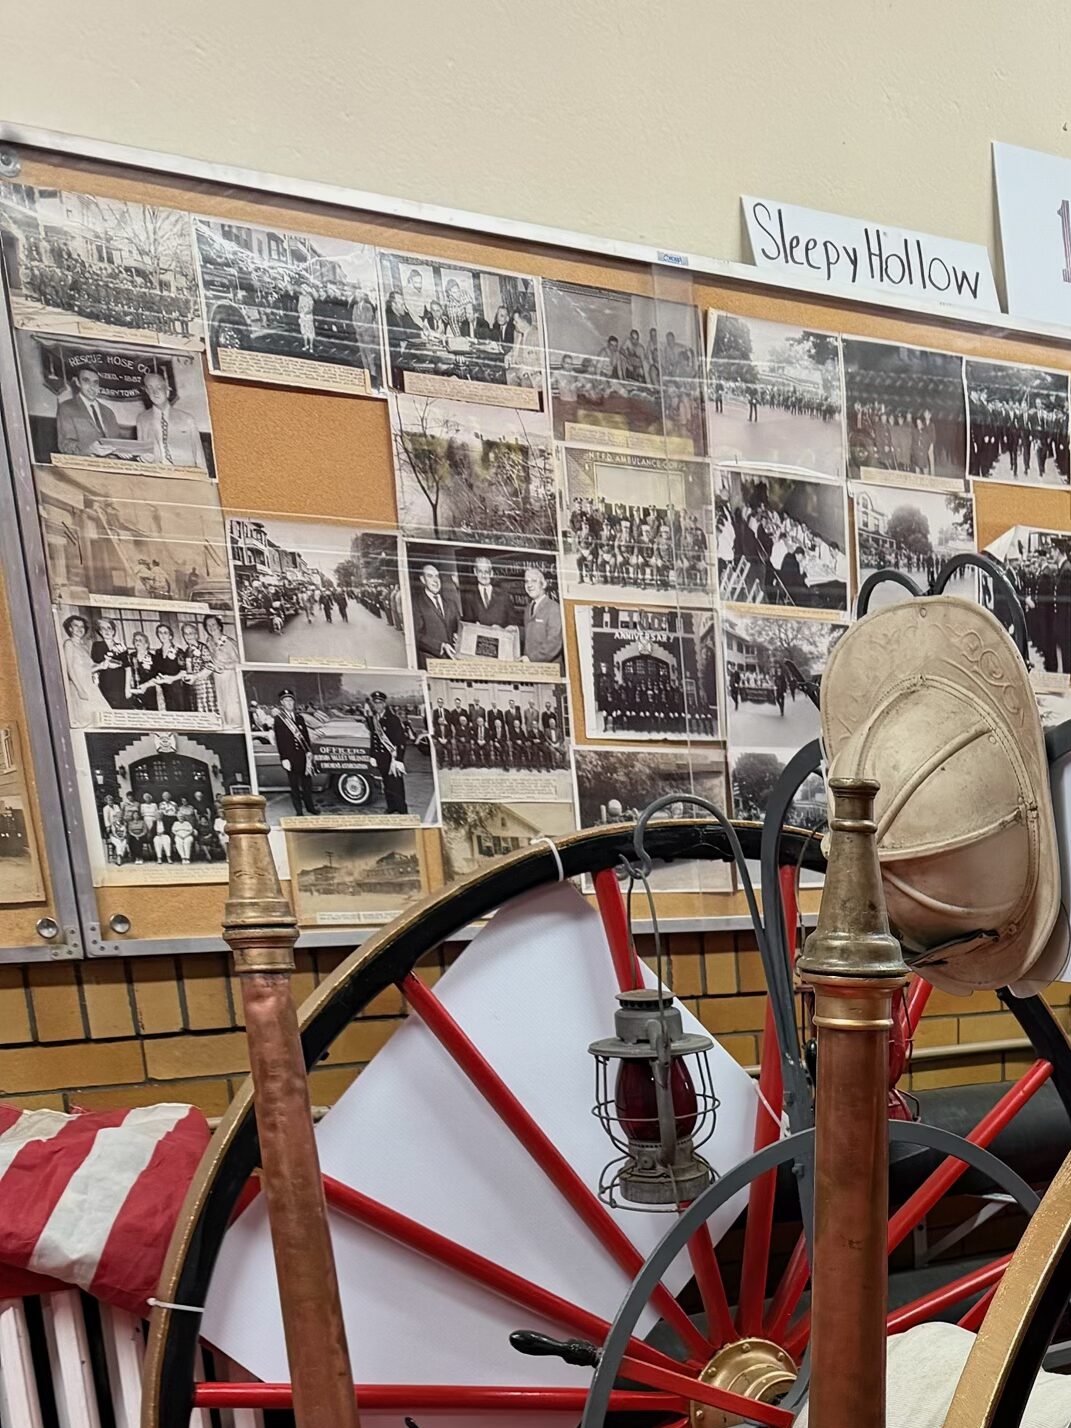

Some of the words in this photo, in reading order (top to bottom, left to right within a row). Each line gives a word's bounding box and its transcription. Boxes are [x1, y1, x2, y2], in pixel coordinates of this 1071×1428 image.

[752, 202, 859, 284] Sleepy
[862, 227, 981, 300] Hollow
[68, 353, 103, 367] RESCUE
[107, 356, 134, 370] HOSE
[613, 630, 675, 643] ANNIVERSARY
[319, 746, 367, 755] OFFICERS
